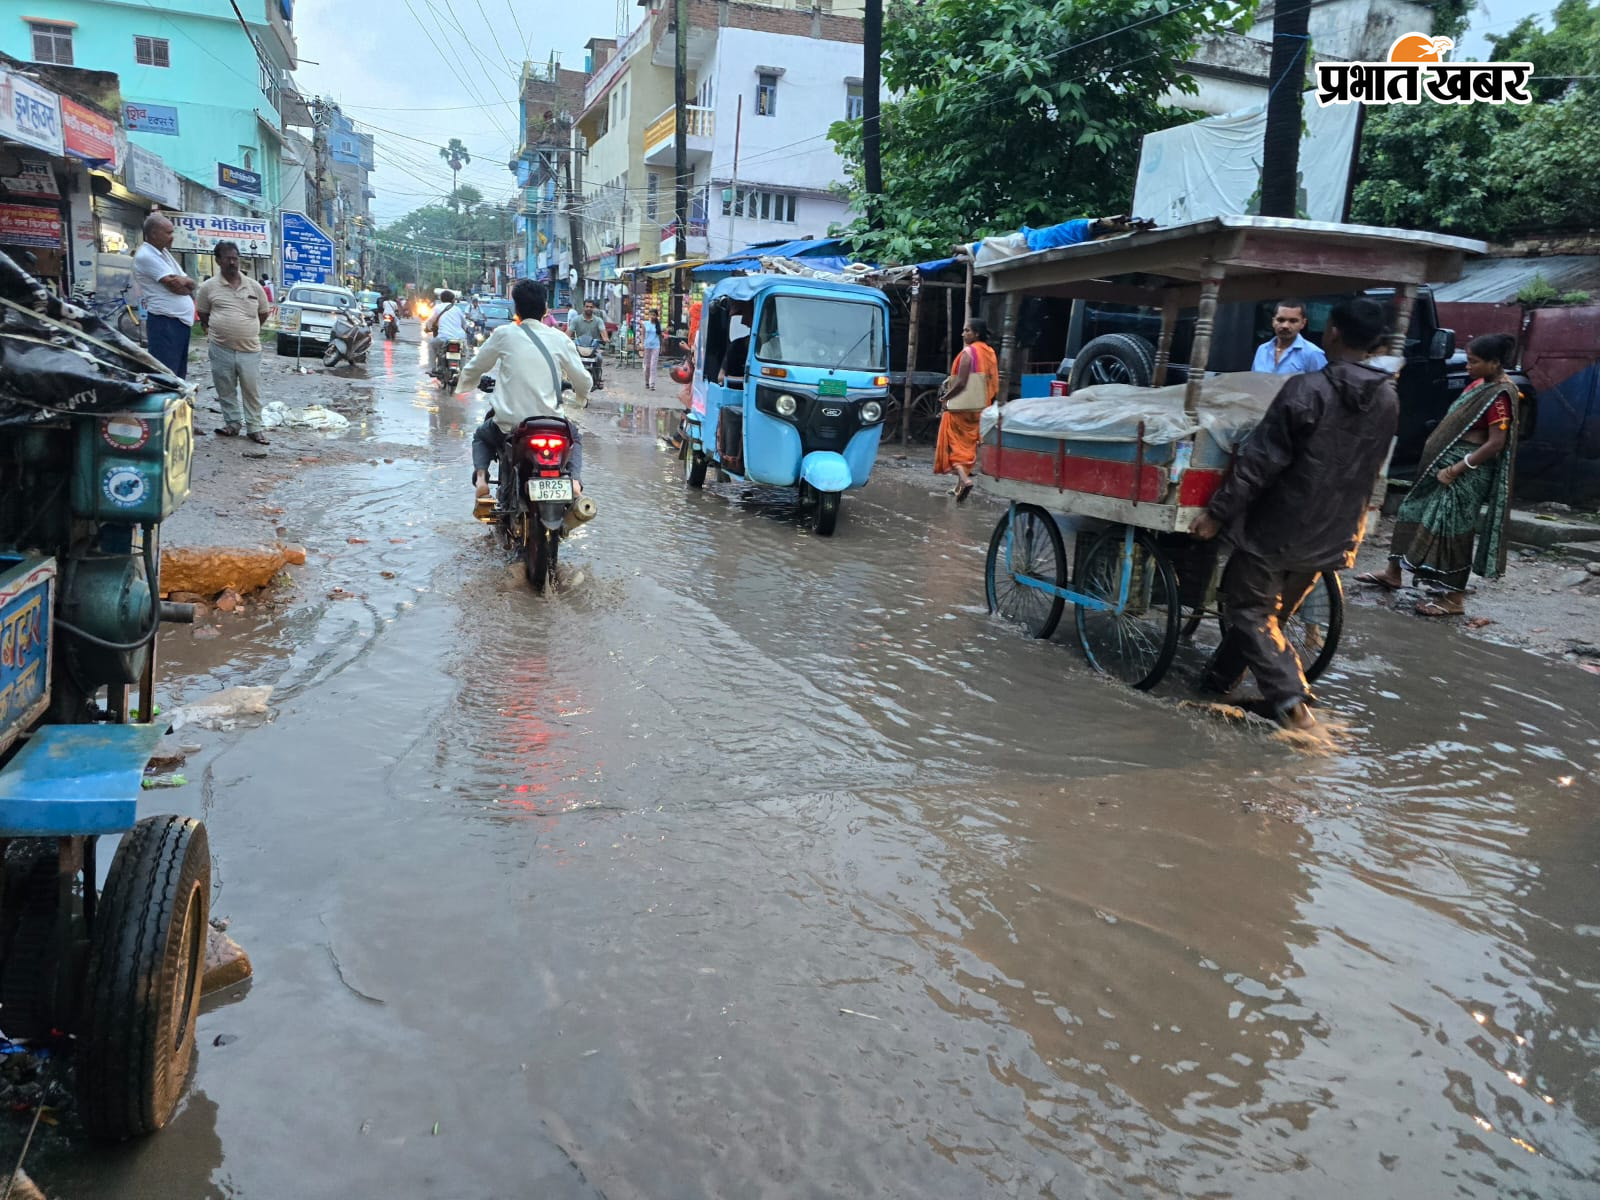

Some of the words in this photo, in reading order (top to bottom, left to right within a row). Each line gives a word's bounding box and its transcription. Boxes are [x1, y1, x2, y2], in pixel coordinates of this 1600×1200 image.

[126, 105, 147, 121] शिव
[210, 215, 266, 233] मेडिकल
[538, 480, 564, 490] BR25
[537, 490, 568, 499] J6757
